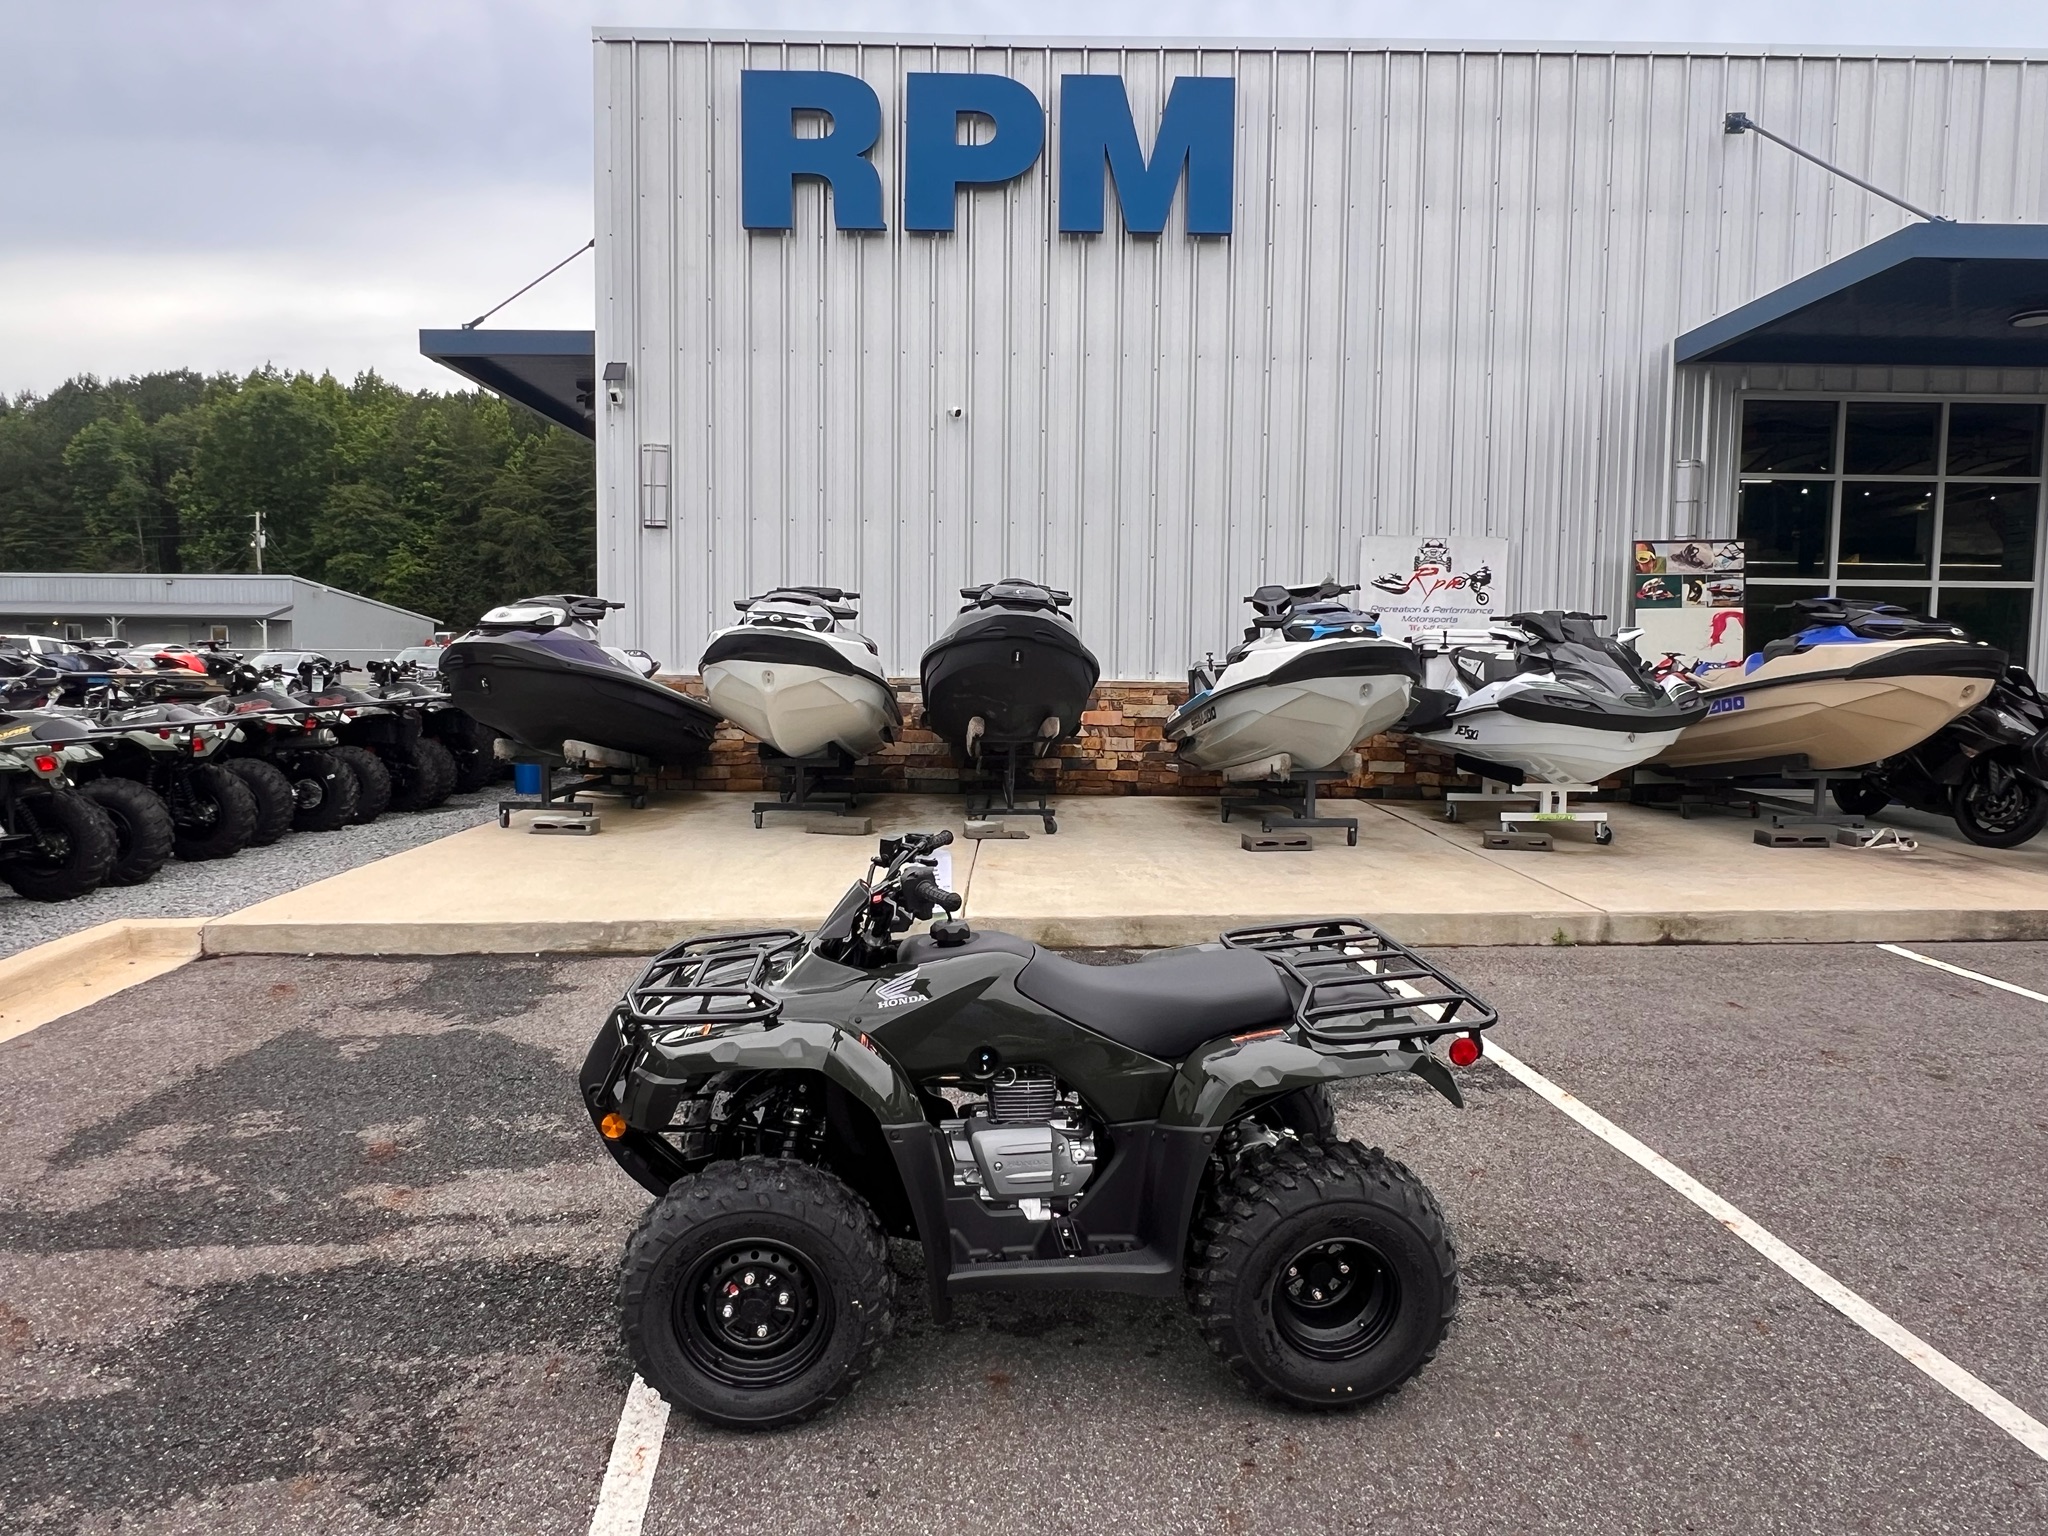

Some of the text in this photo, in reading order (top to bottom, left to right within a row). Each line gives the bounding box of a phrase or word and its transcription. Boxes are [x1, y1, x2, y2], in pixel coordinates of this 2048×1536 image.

[741, 70, 1236, 236] RPM
[1370, 605, 1495, 615] Recreation & Performance
[1401, 615, 1458, 624] Motorsports
[878, 994, 929, 1009] HONDA
